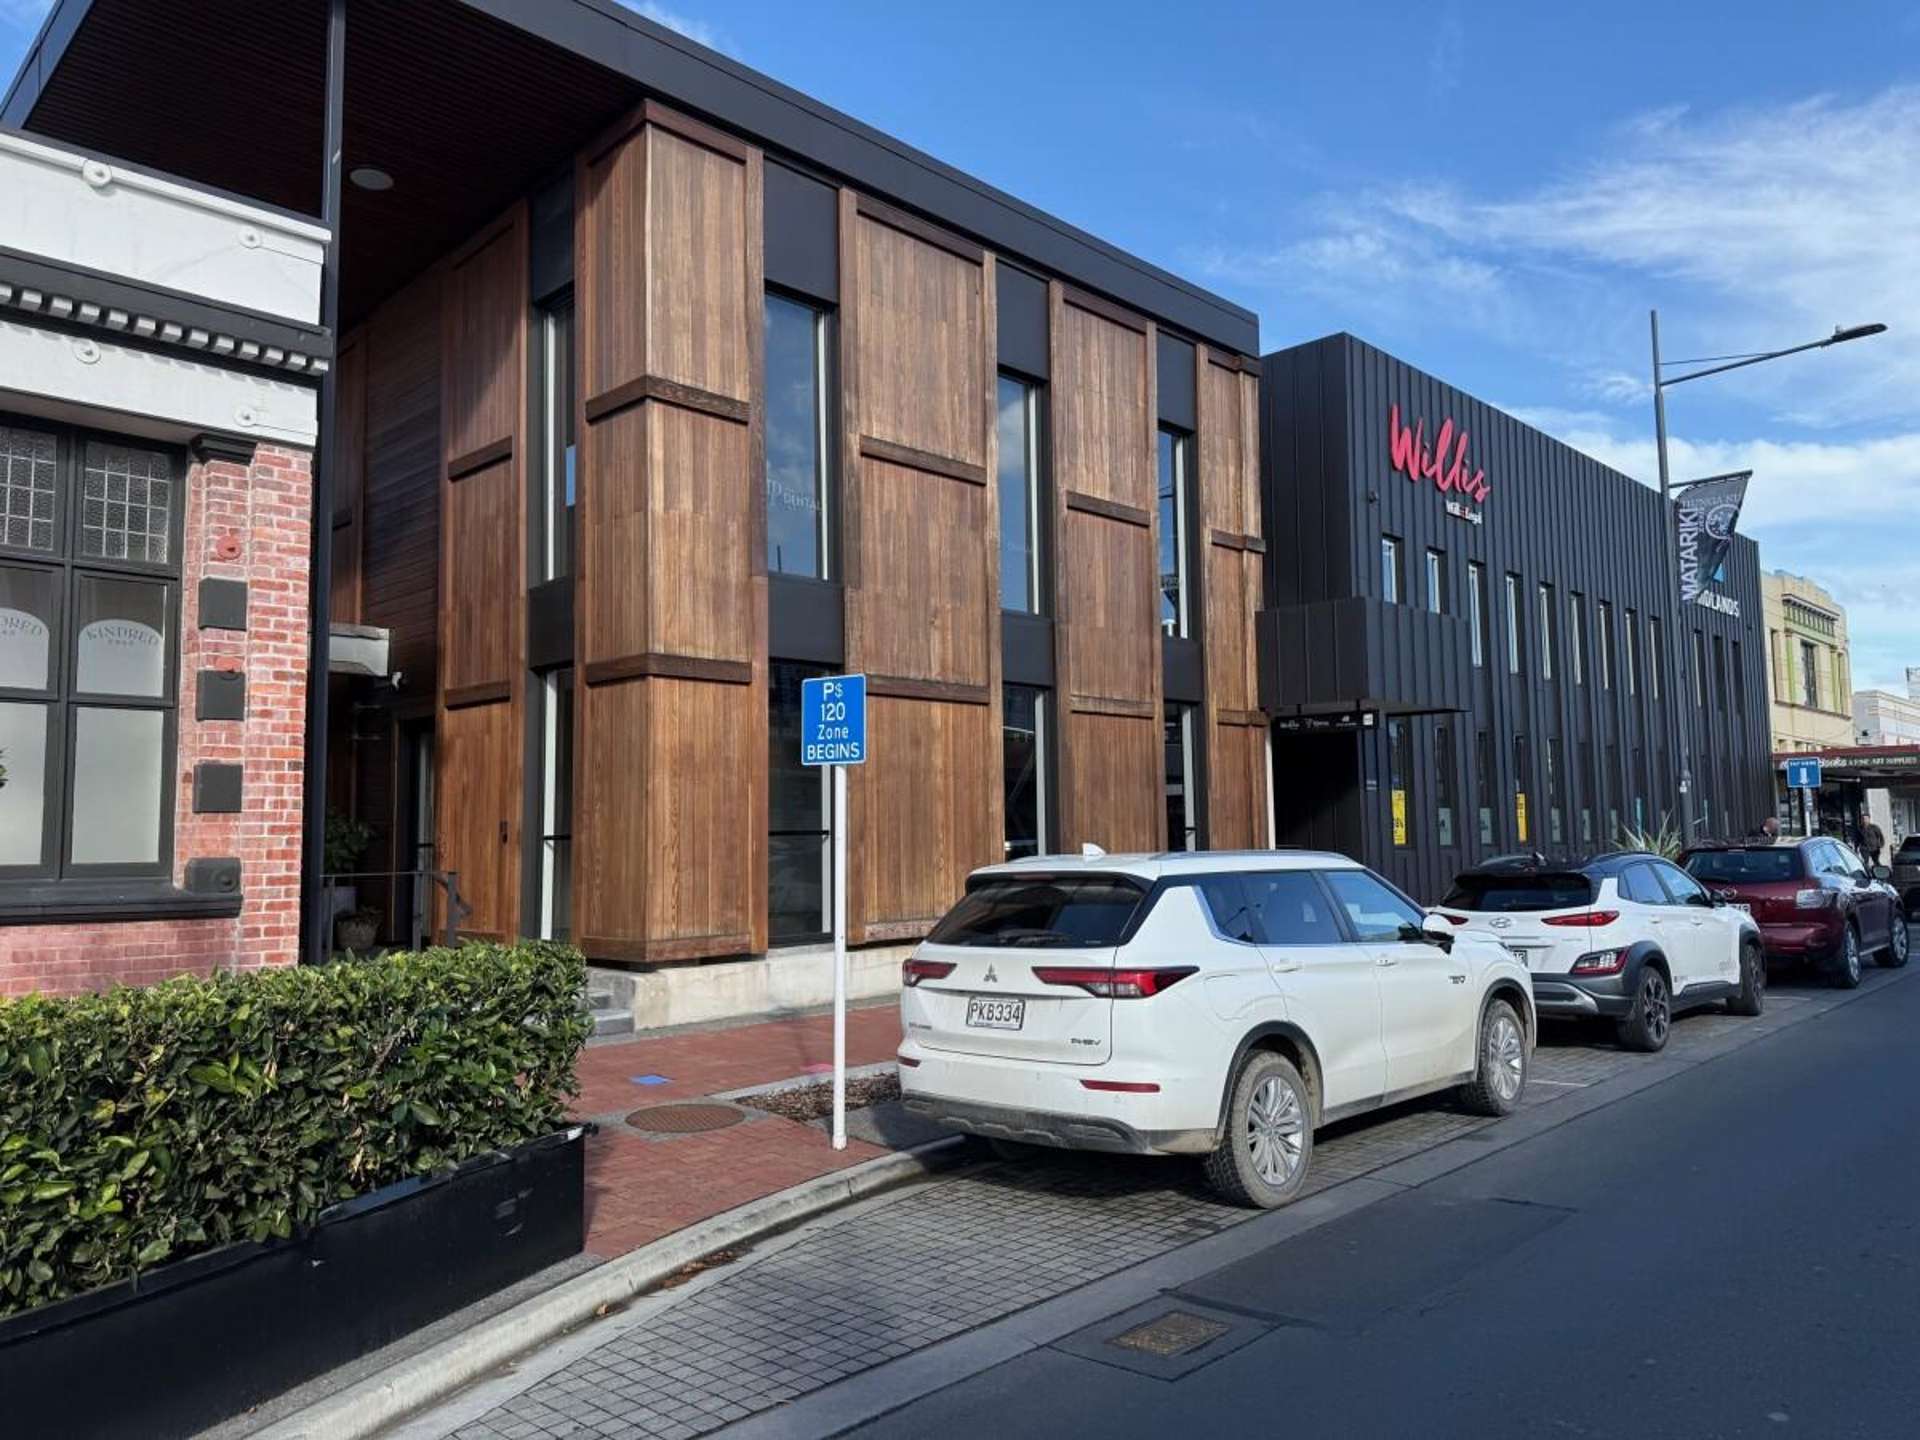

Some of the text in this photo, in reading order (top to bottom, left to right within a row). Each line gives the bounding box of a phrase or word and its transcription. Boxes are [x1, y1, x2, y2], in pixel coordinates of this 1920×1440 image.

[1390, 403, 1490, 503] Willis
[1678, 507, 1699, 601] MATARIKI
[820, 702, 846, 722] 120
[817, 724, 849, 740] Zone
[807, 742, 860, 760] BEGINS
[970, 1002, 1021, 1023] PKB334
